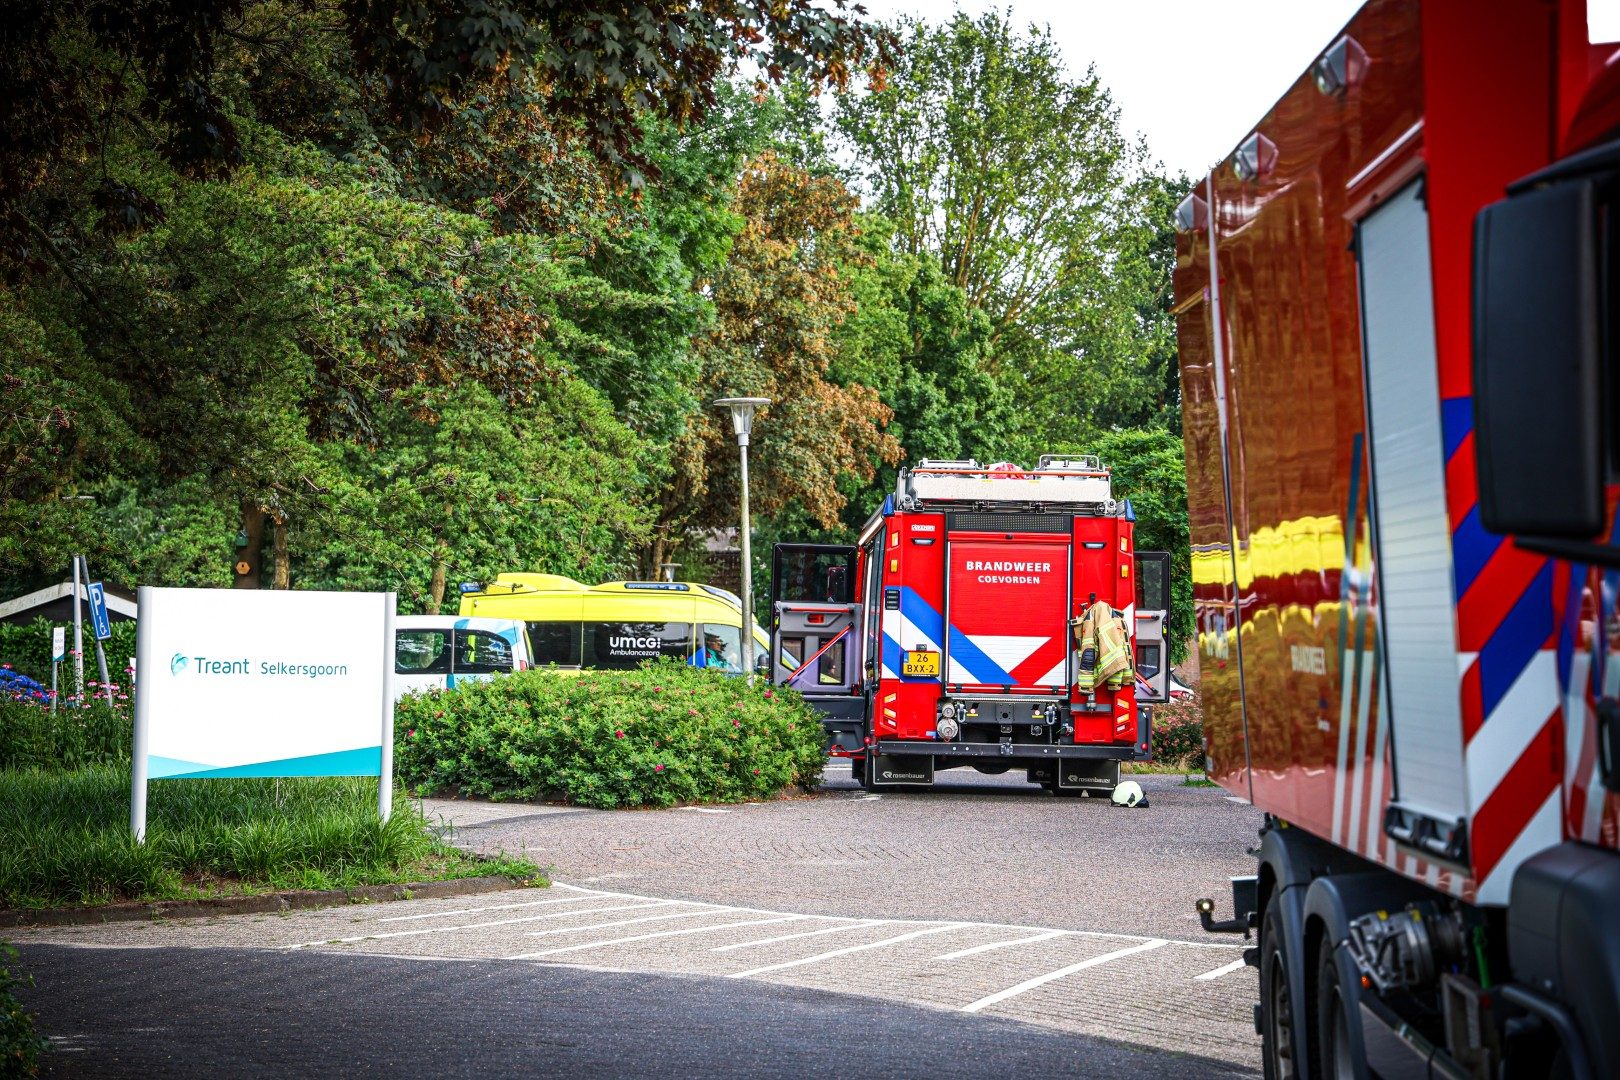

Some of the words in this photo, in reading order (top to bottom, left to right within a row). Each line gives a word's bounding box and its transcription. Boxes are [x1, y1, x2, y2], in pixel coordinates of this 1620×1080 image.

[965, 560, 1051, 572] BRANDWEER
[977, 575, 1040, 584] COEVORDEN
[609, 649, 660, 657] Ambulancezorg
[916, 653, 929, 663] 26
[194, 657, 250, 674] Treant
[260, 661, 347, 678] Selkersgoorn
[907, 664, 935, 673] BXX-2
